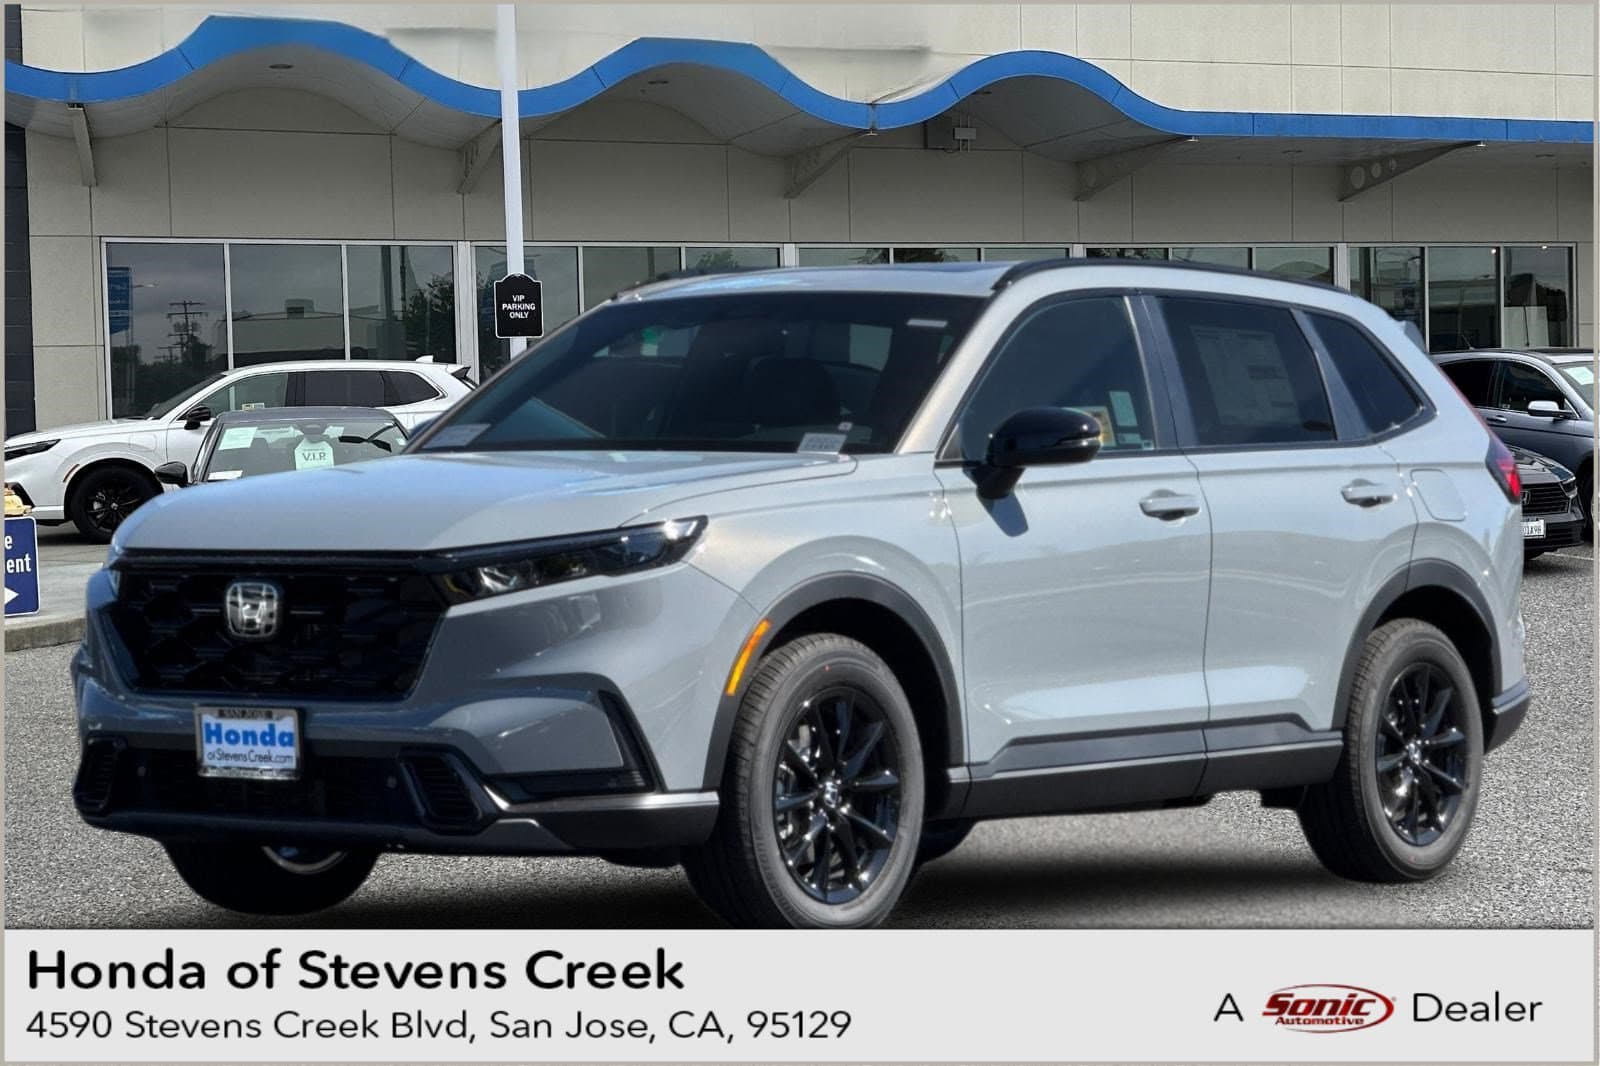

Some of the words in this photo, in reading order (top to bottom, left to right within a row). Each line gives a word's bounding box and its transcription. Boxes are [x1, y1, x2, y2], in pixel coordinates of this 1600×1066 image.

[512, 294, 525, 302] VIP
[502, 303, 536, 311] PARKING
[509, 311, 529, 319] ONLY
[6, 553, 32, 574] ent
[204, 722, 295, 747] Honda
